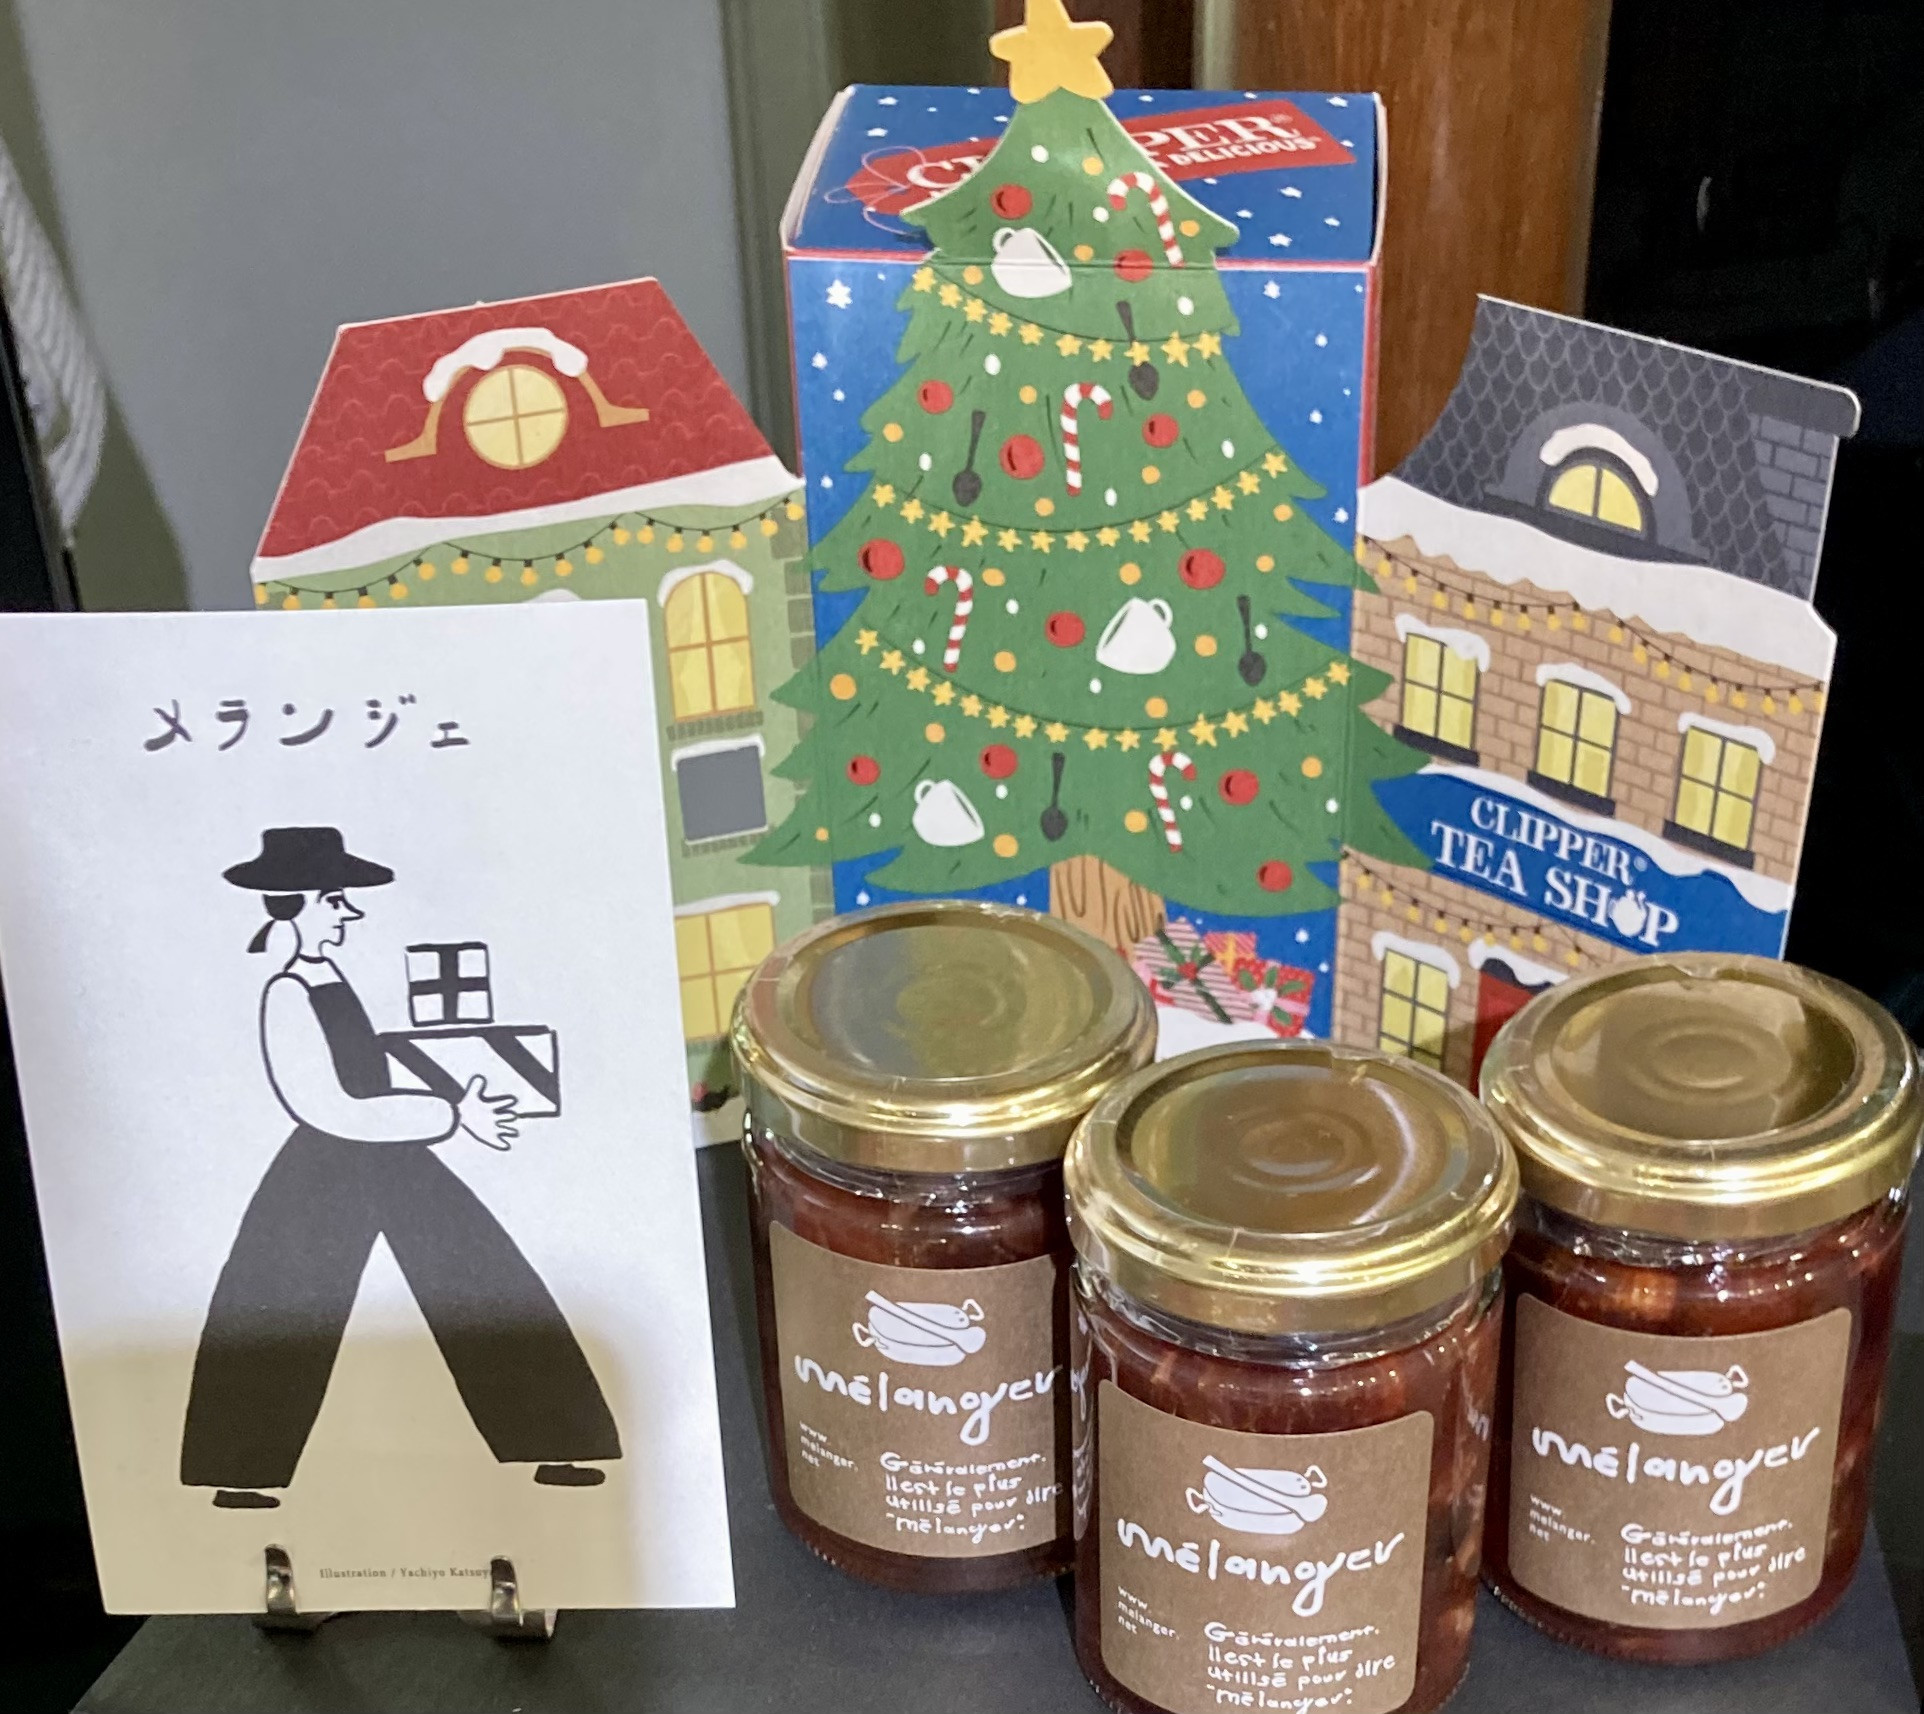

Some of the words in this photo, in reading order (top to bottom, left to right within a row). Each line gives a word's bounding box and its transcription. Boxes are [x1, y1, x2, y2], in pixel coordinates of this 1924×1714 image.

[143, 694, 471, 752] メランジェ
[1430, 820, 1528, 897] TEA
[1544, 865, 1680, 947] SHOP
[973, 1473, 1022, 1499] plus
[971, 1496, 1017, 1518] pour
[1717, 1542, 1768, 1569] plus
[320, 1568, 387, 1579] Illustration
[400, 1568, 446, 1581] Yachiyo
[450, 1568, 493, 1580] Katsuy
[1713, 1564, 1761, 1588] pour
[1302, 1646, 1353, 1672] plus
[1298, 1669, 1347, 1691] pour
